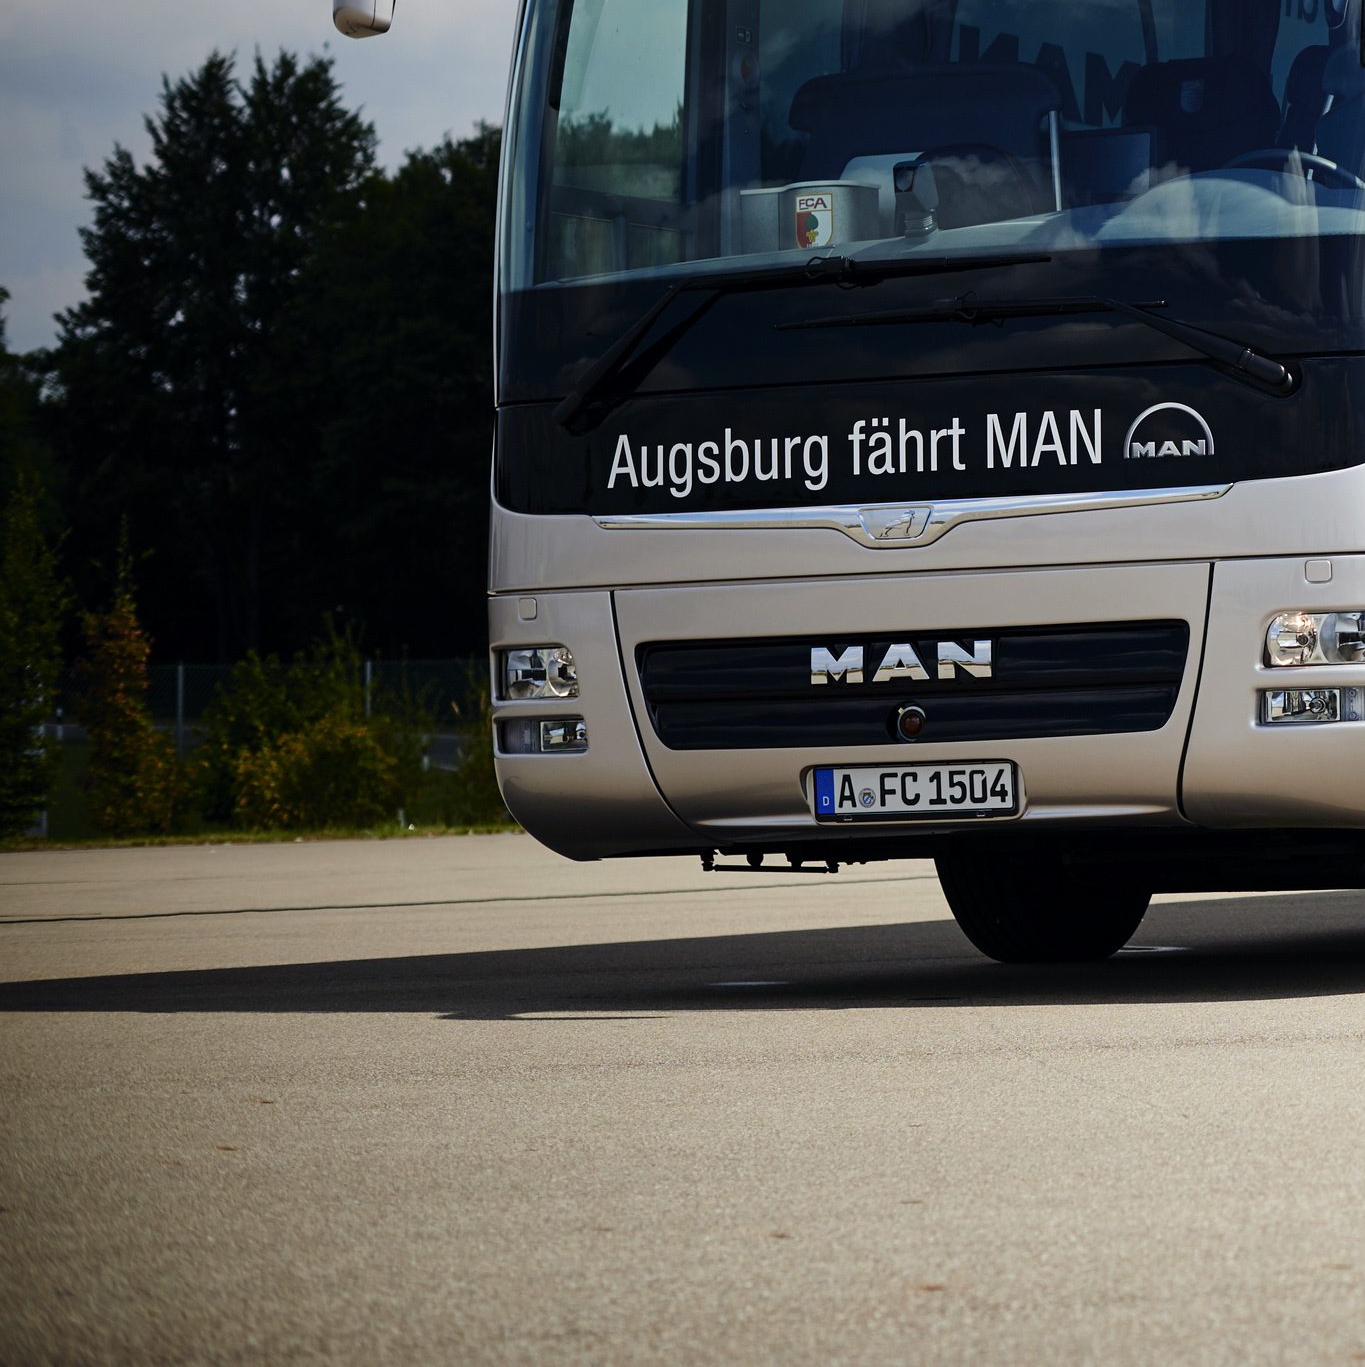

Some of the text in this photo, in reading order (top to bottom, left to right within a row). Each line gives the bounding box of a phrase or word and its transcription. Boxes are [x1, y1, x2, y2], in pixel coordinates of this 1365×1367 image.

[799, 197, 828, 209] FCA
[607, 408, 1102, 499] Augsburg fährt MAN
[1131, 438, 1207, 459] MAN
[810, 639, 993, 685] MAN
[822, 796, 830, 806] D
[838, 768, 1009, 808] A FC 1504
